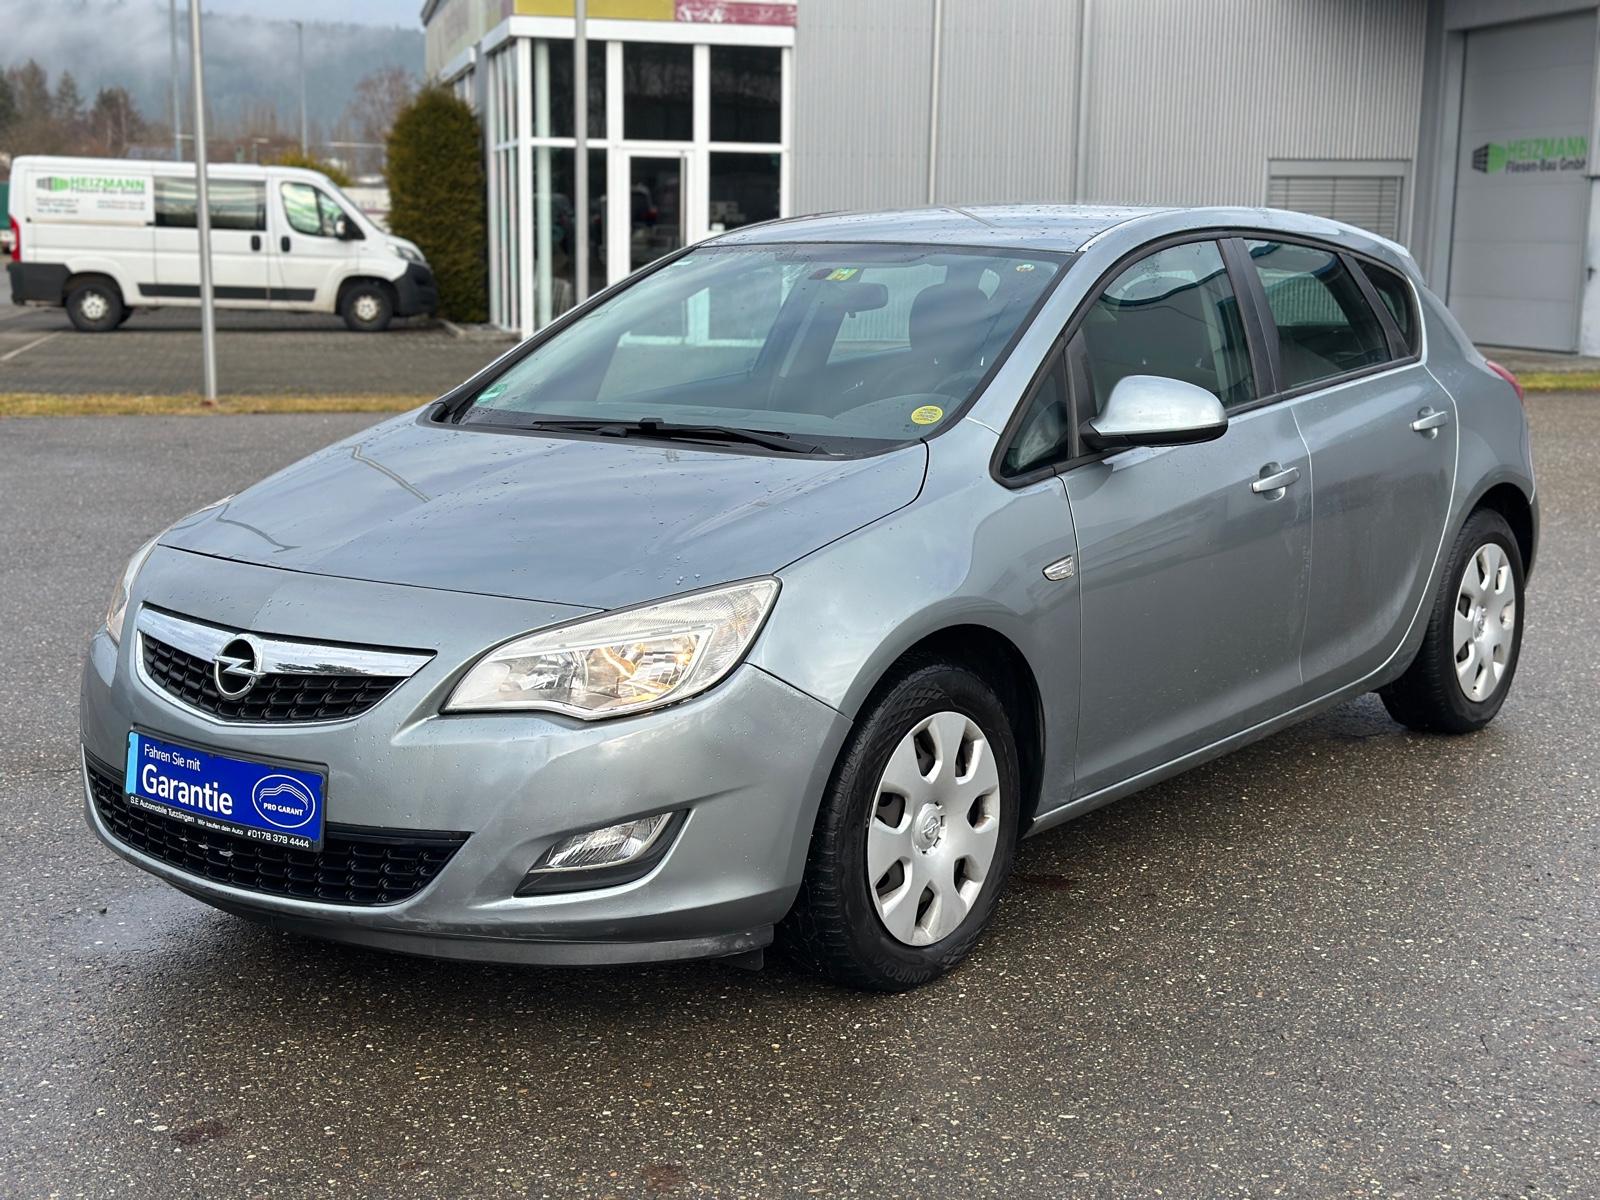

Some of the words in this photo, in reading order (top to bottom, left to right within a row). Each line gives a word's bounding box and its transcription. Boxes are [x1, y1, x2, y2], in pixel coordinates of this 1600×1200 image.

[1506, 136, 1587, 160] HEIZMANN
[70, 176, 145, 190] HEIZMANN
[144, 744, 170, 762] Fahren
[172, 752, 185, 767] Sie
[186, 758, 200, 771] mit
[142, 764, 232, 815] Garantie
[263, 802, 277, 811] PRO
[278, 805, 304, 816] GARANT
[140, 800, 167, 815] Automobile
[231, 827, 244, 836] Auto
[272, 834, 288, 844] 379
[289, 837, 310, 848] 4444
